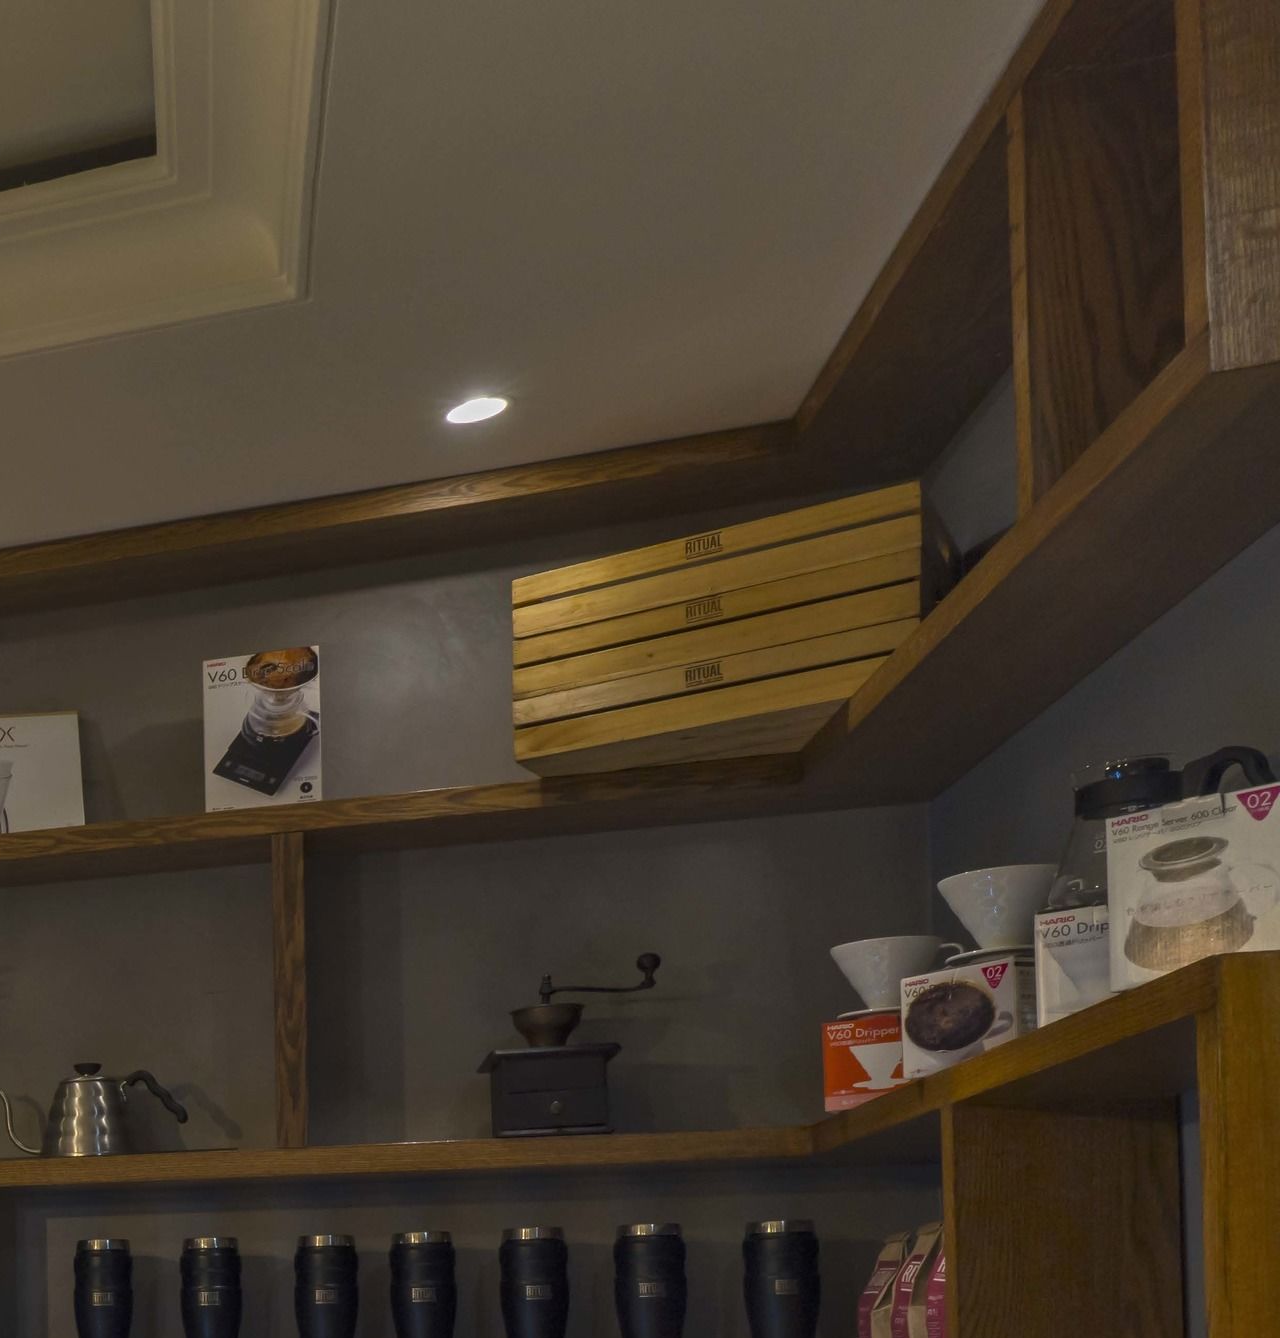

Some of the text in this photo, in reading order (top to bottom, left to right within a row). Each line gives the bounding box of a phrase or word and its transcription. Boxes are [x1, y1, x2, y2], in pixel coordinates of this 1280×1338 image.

[685, 534, 723, 554] RITUAL
[685, 598, 723, 619] RITUAL
[208, 668, 237, 683] V60
[685, 663, 724, 683] RITUAL
[1247, 791, 1272, 808] 02
[1111, 813, 1149, 828] HARIO
[1111, 826, 1130, 836] V60
[1162, 816, 1188, 826] Server
[1191, 809, 1210, 821] 600
[1040, 915, 1075, 926] HARIO
[1040, 924, 1071, 939] V60
[986, 965, 1002, 979] 02
[905, 978, 929, 987] HARIO
[827, 1026, 899, 1041] V60 Dripper
